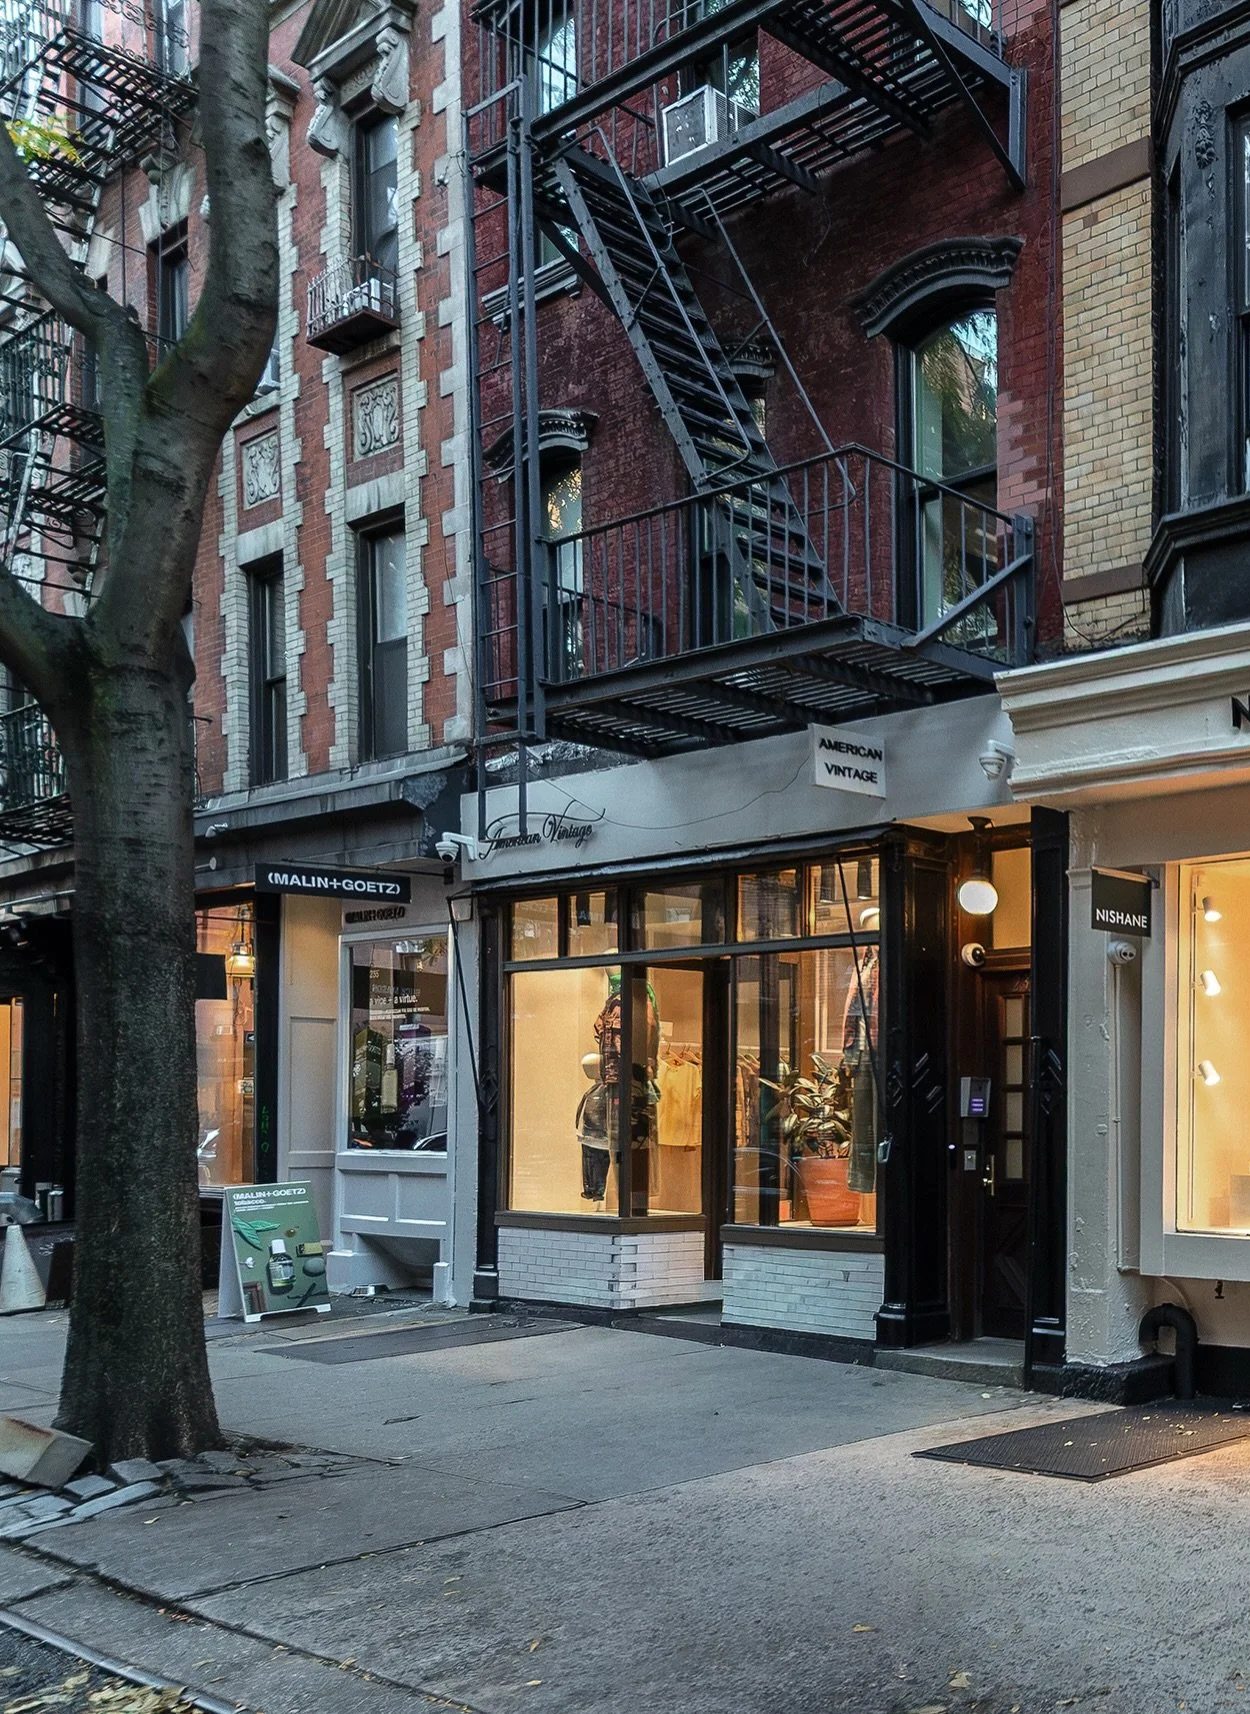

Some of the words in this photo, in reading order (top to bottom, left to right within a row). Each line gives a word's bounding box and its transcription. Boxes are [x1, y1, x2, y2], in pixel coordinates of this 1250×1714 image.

[819, 738, 883, 761] AMERICAN
[824, 762, 878, 784] VINTAGE
[542, 800, 596, 848] Vintage
[267, 872, 401, 895] (MALIN+GOETZ)
[1096, 908, 1148, 928] NISHANE
